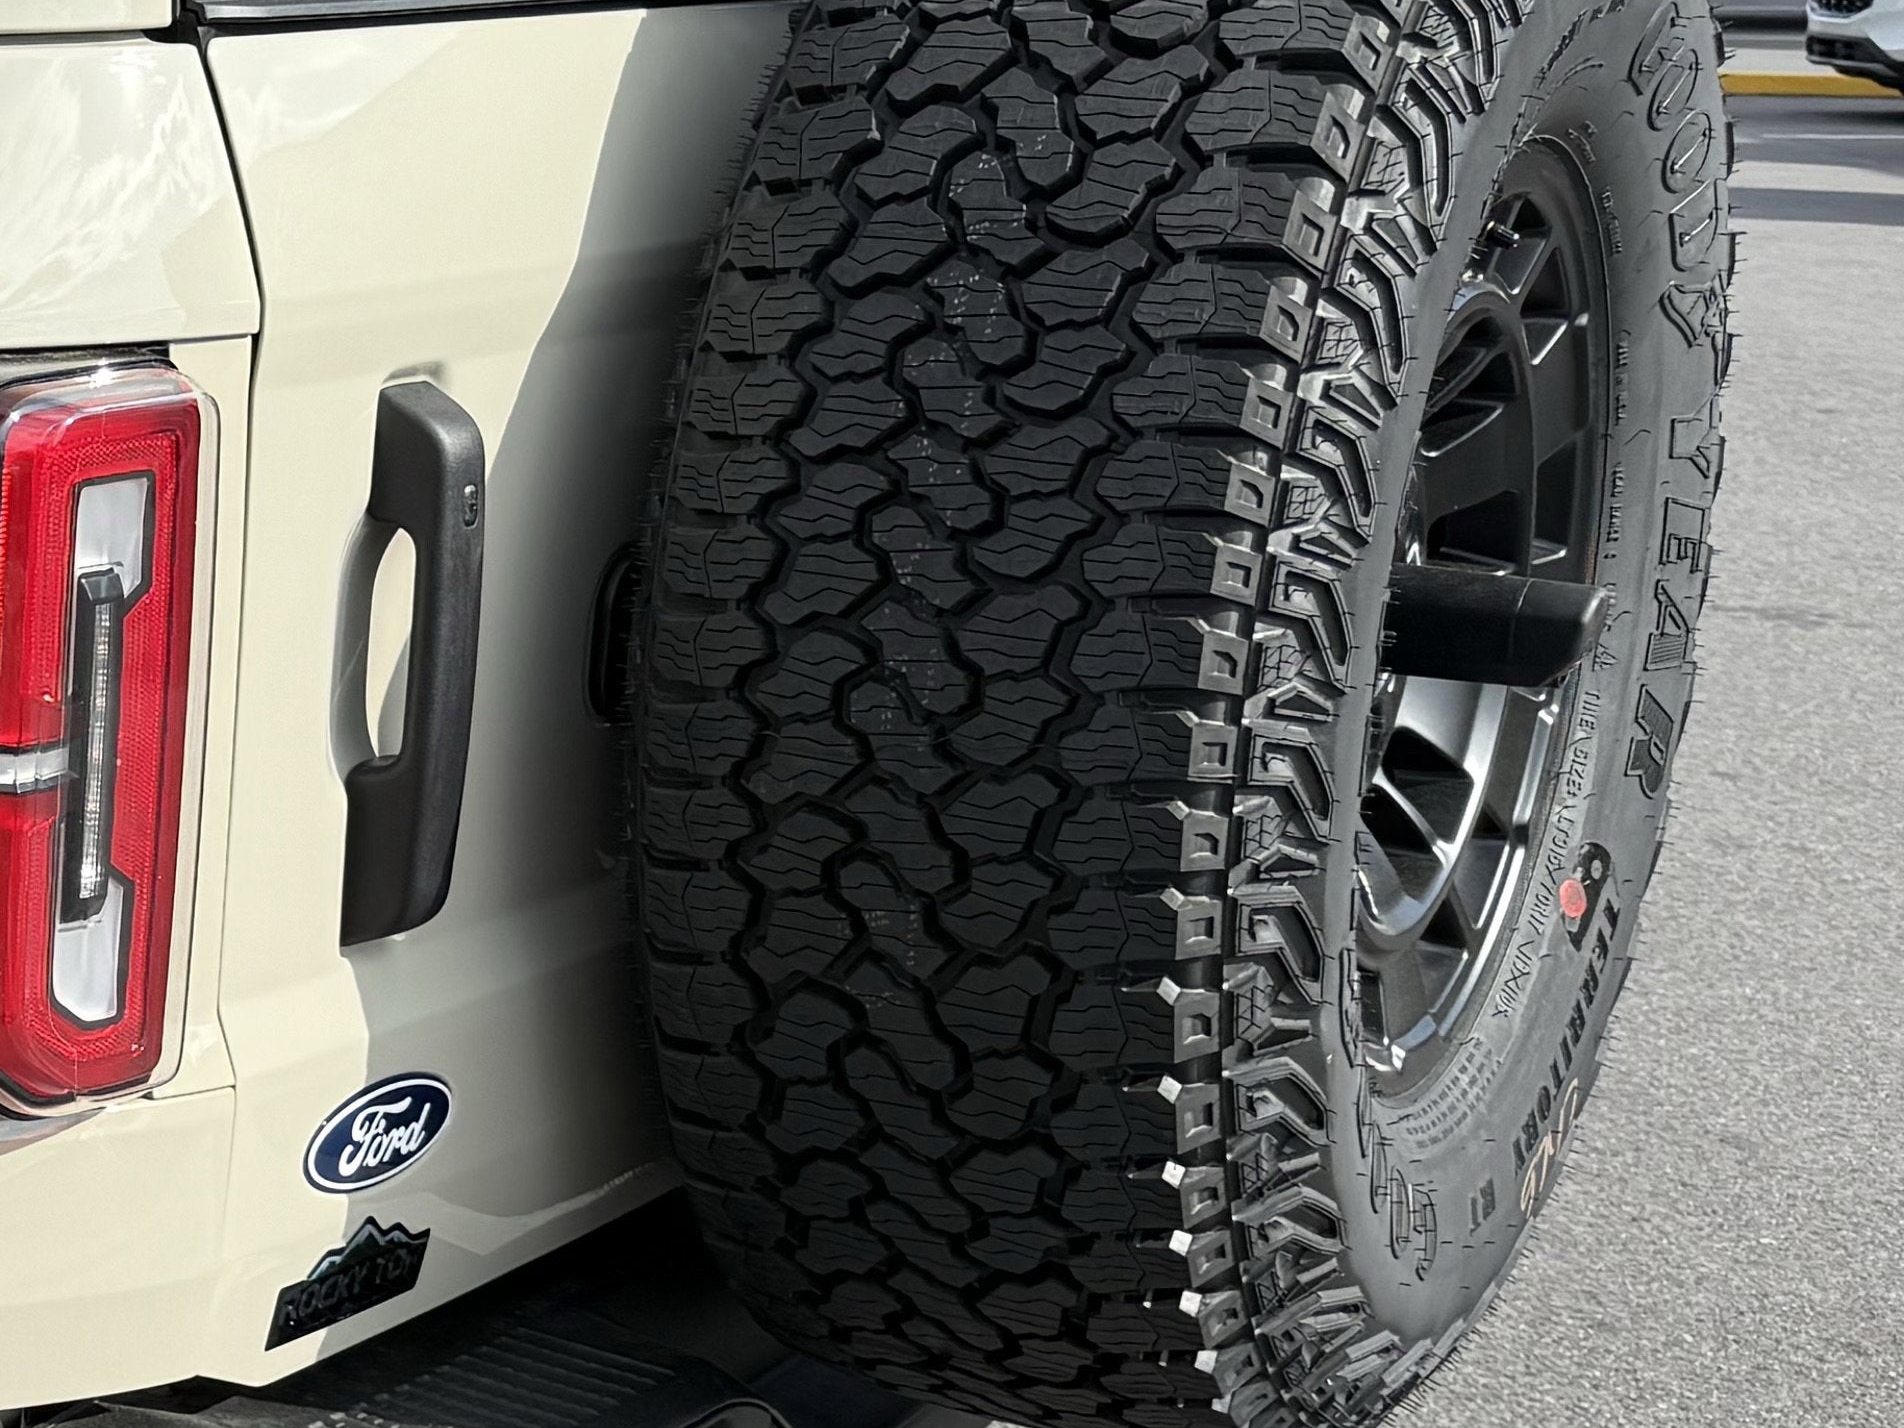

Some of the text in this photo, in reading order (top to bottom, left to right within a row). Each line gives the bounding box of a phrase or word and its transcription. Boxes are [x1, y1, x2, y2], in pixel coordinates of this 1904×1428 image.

[1513, 894, 1619, 1174] TERRITORY
[338, 1095, 432, 1178] Ford
[277, 1260, 371, 1327] ROCKY
